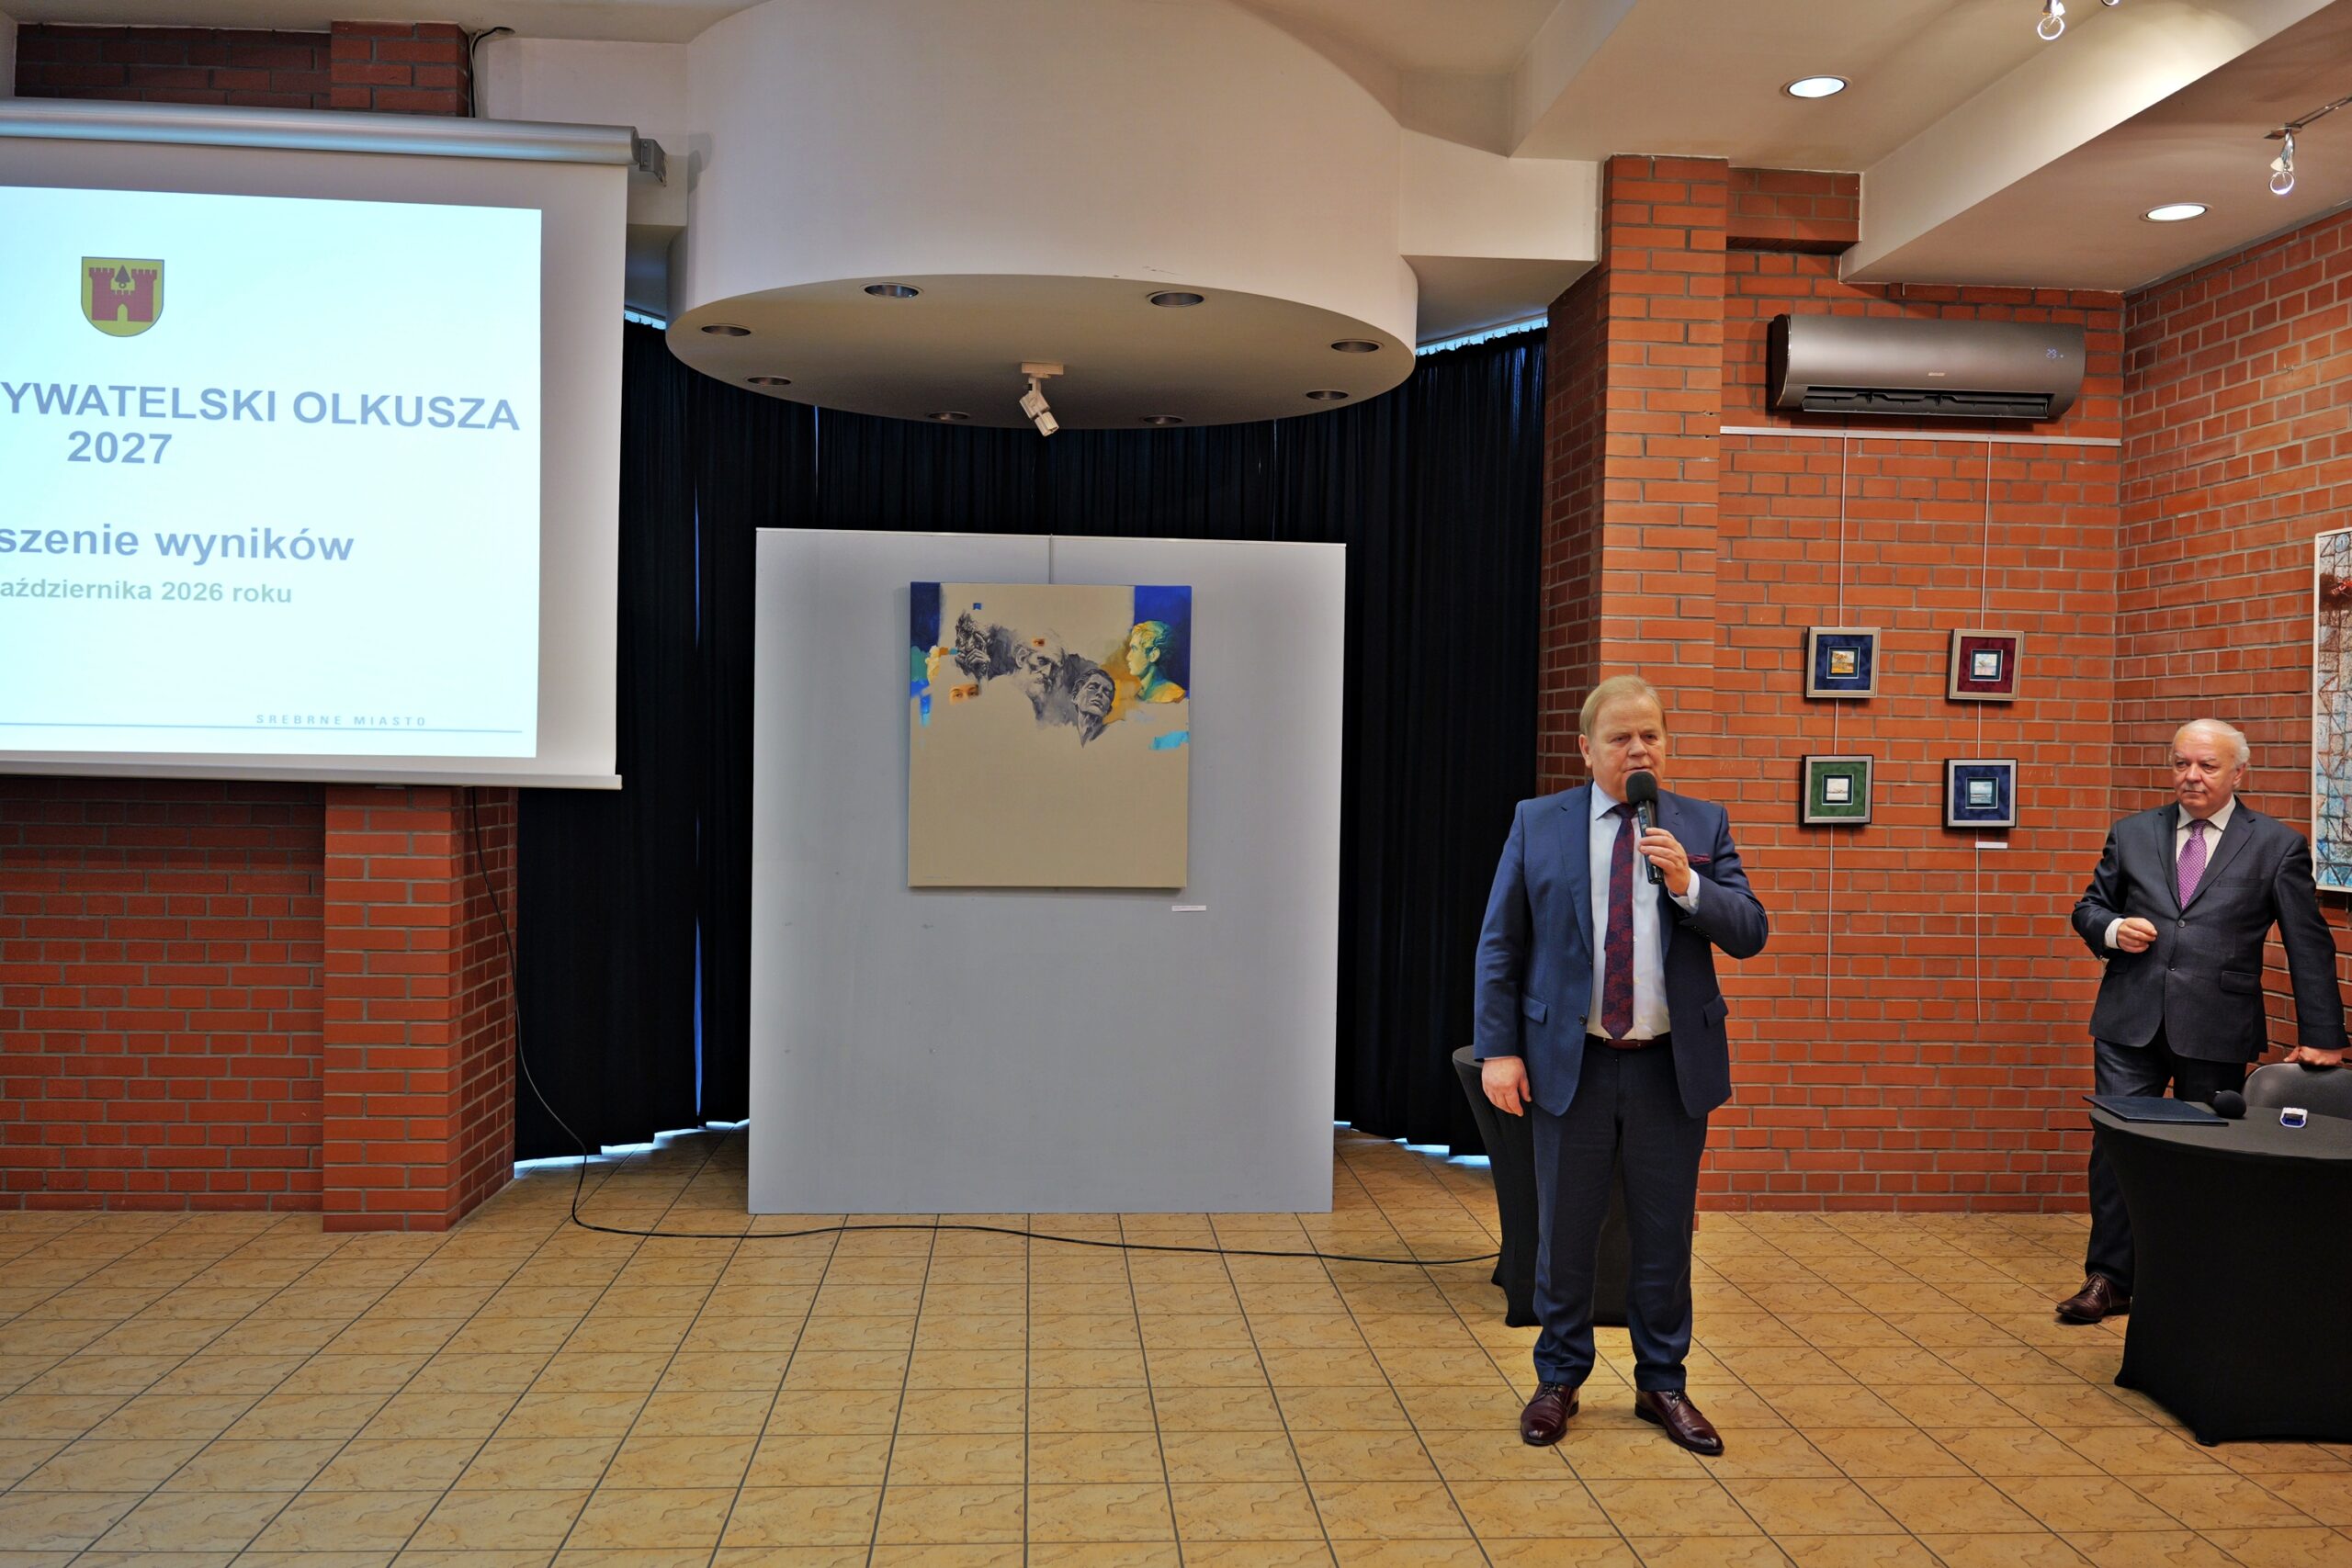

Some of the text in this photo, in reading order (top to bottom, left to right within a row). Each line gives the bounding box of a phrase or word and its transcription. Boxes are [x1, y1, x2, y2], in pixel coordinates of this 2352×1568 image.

[1, 381, 521, 432] YWATELSKI OLKUSZA
[67, 431, 173, 465] 2027
[0, 524, 355, 567] szenie wyników
[1, 578, 292, 604] aździernika 2026 roku
[256, 714, 426, 728] SREBRNE MIASTO
